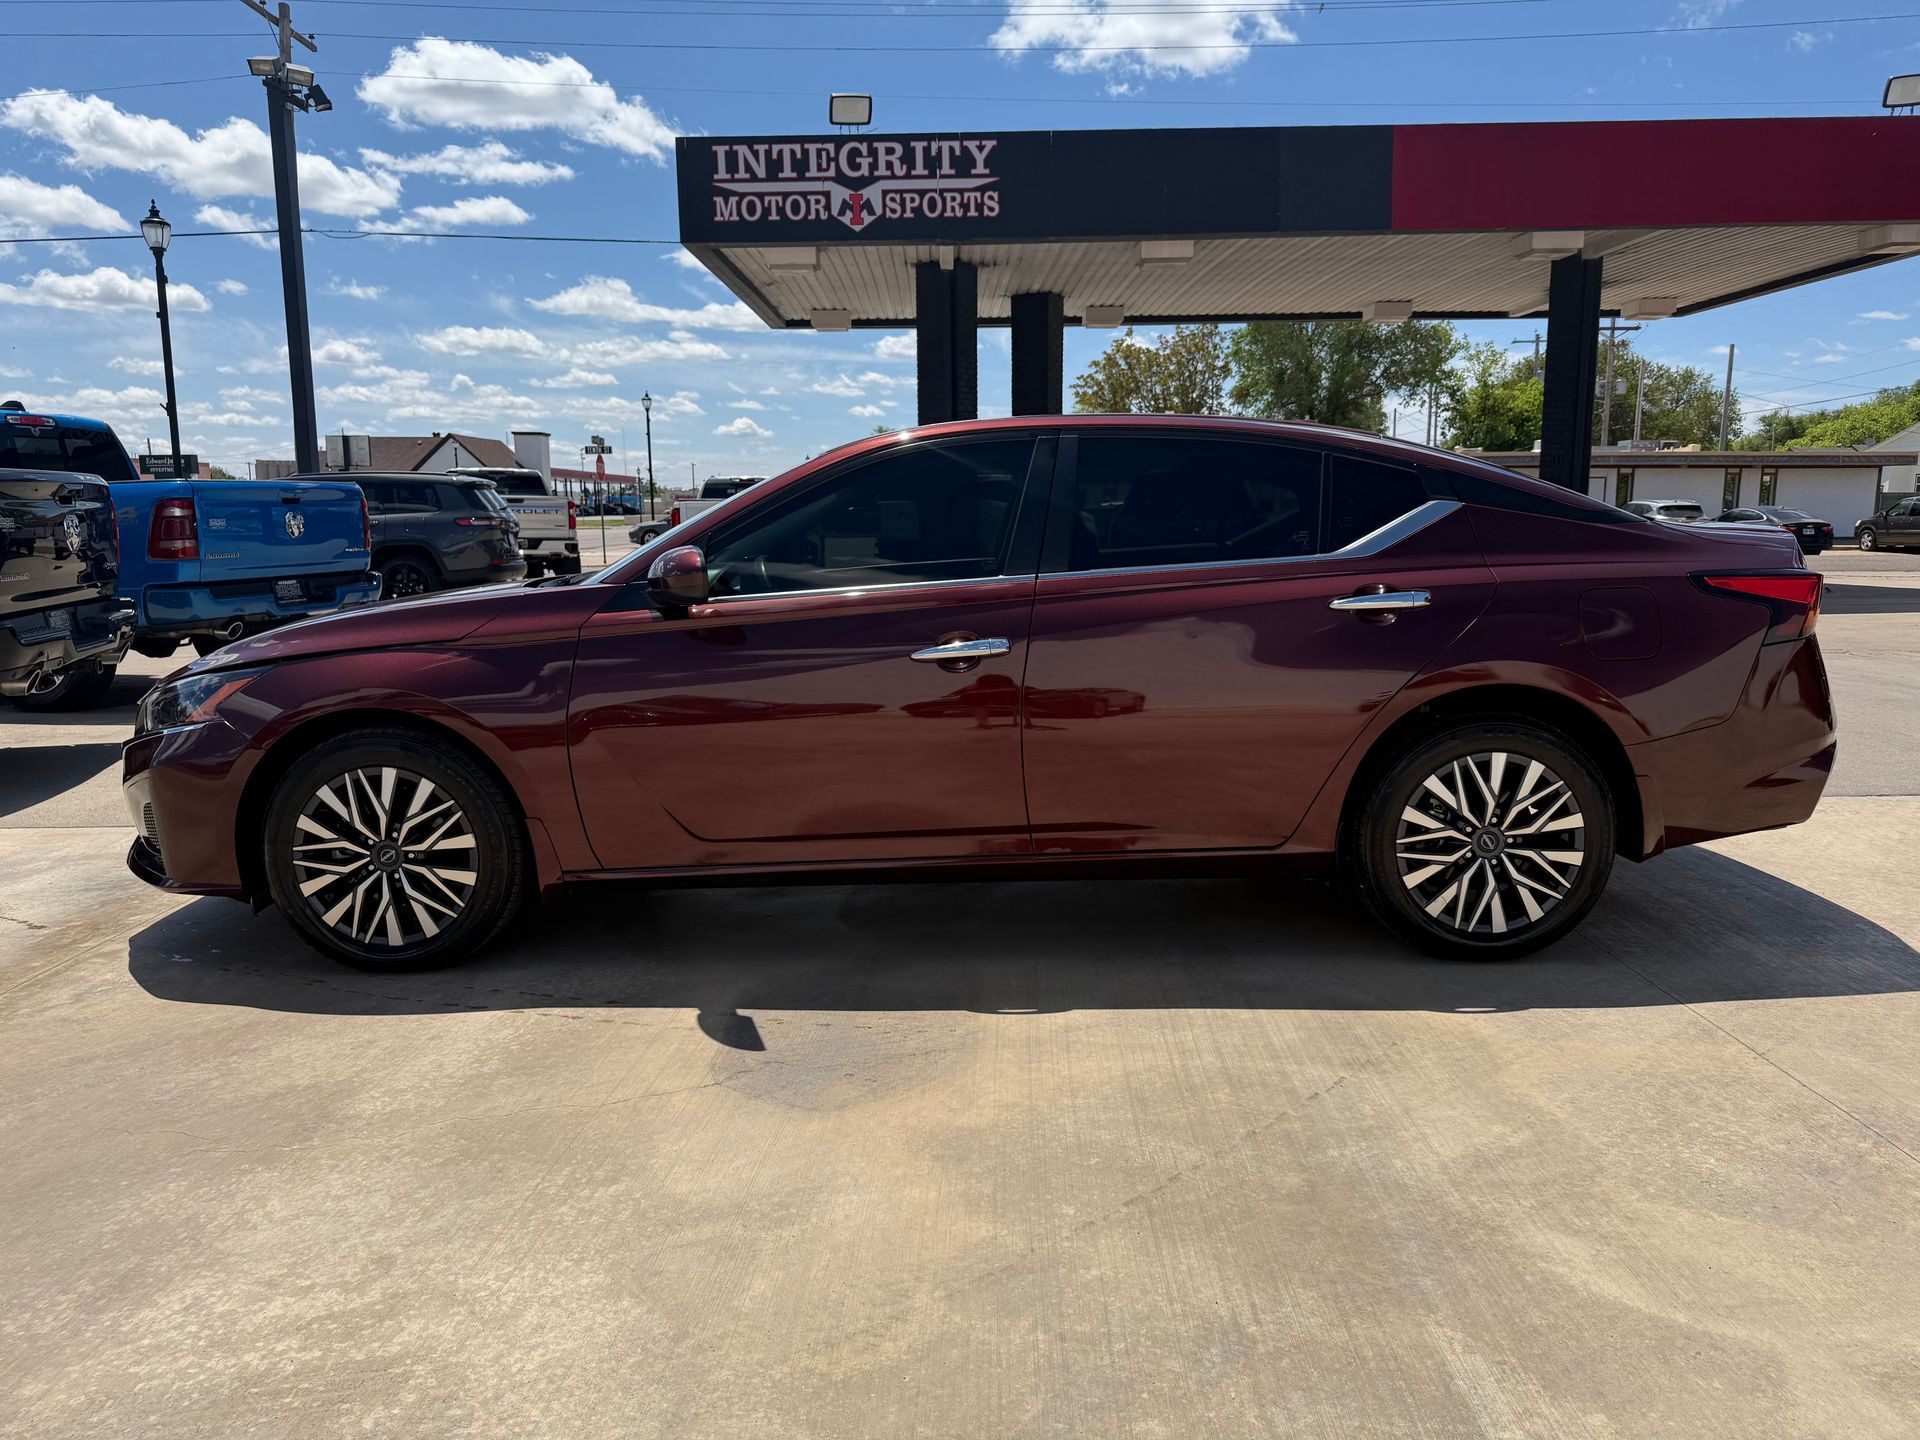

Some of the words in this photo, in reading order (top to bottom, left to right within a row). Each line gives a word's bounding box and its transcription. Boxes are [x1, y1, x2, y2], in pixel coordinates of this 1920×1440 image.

[712, 140, 997, 179] INTEGRITY
[713, 194, 828, 222] MOTOR
[885, 190, 1000, 219] SPORTS
